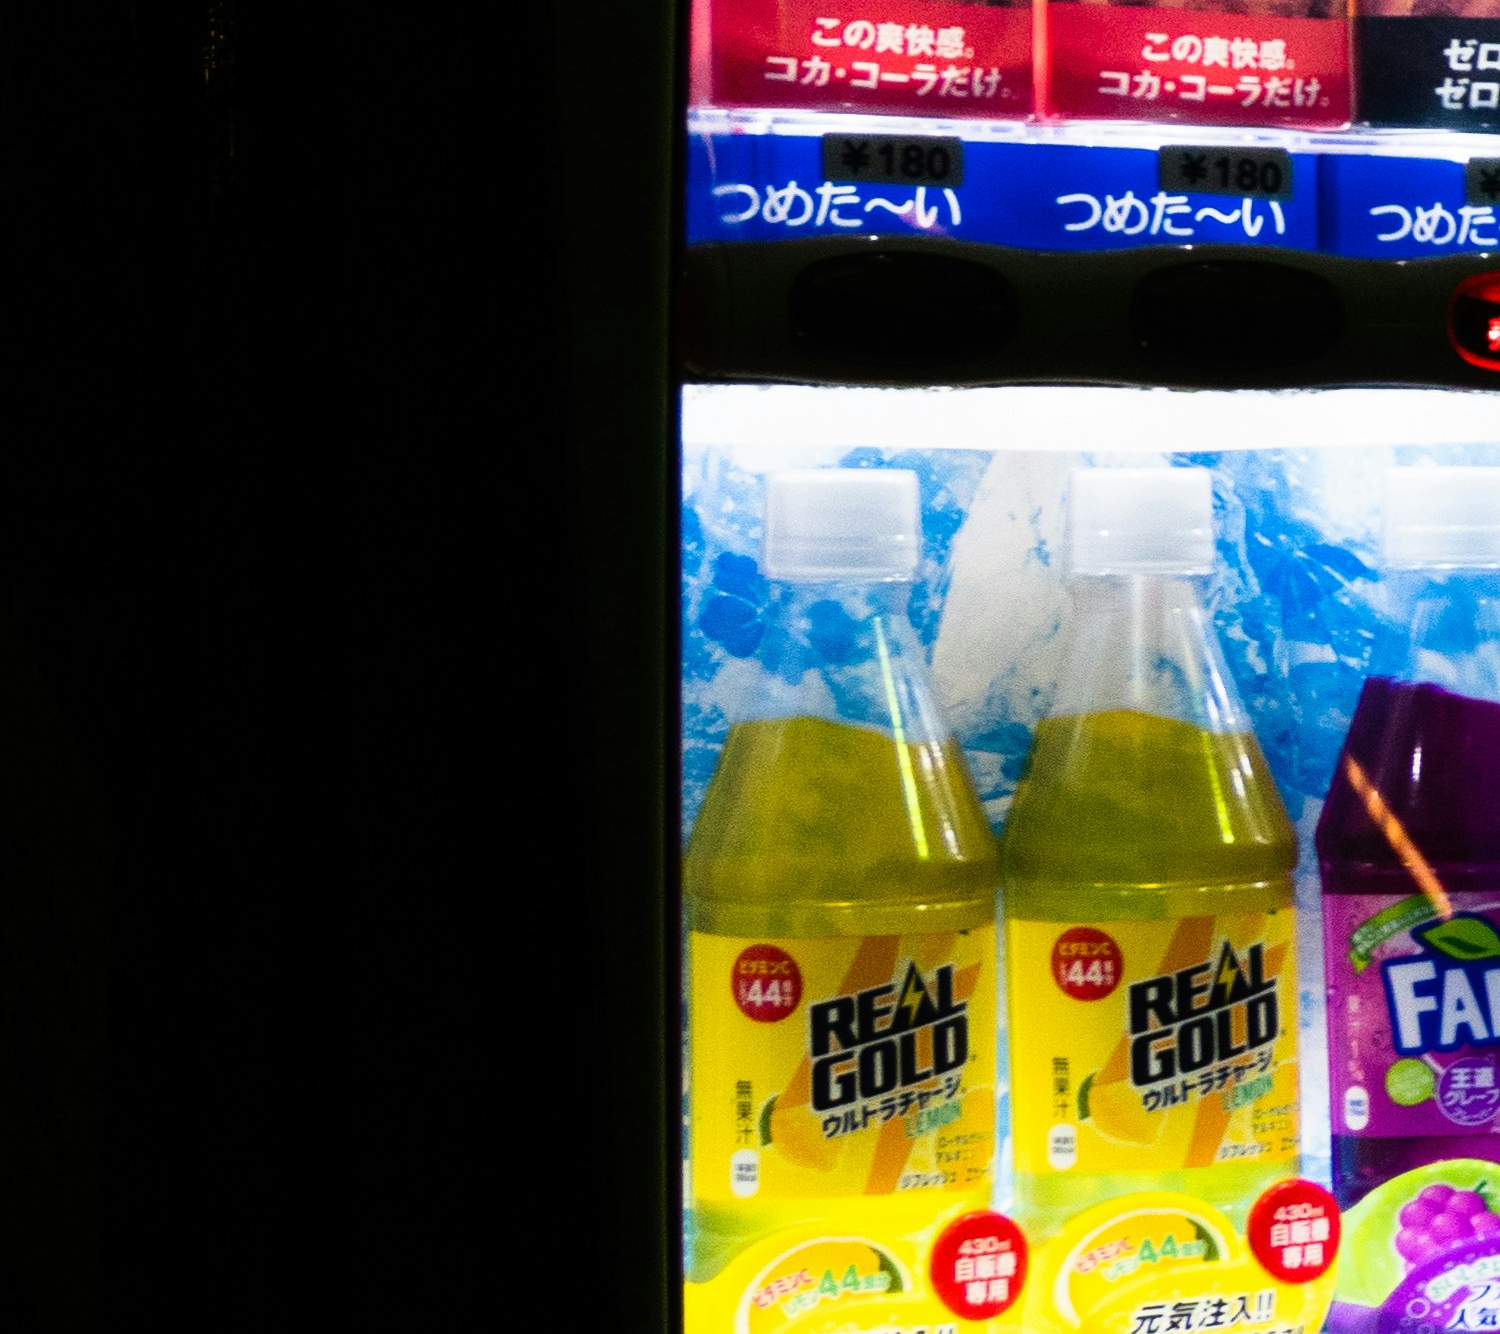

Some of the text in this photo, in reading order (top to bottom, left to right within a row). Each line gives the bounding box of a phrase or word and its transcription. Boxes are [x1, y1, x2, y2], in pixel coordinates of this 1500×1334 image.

[811, 17, 974, 58] この爽快感。
[1141, 32, 1296, 70] この爽快感。
[841, 139, 951, 180] ¥180
[1127, 940, 1278, 1034] REAL
[809, 960, 968, 1057] REAL
[1130, 992, 1279, 1088] GOLD
[812, 1013, 969, 1112] GOLD
[954, 1250, 1017, 1281] 自販機
[964, 1280, 1009, 1305] 専用
